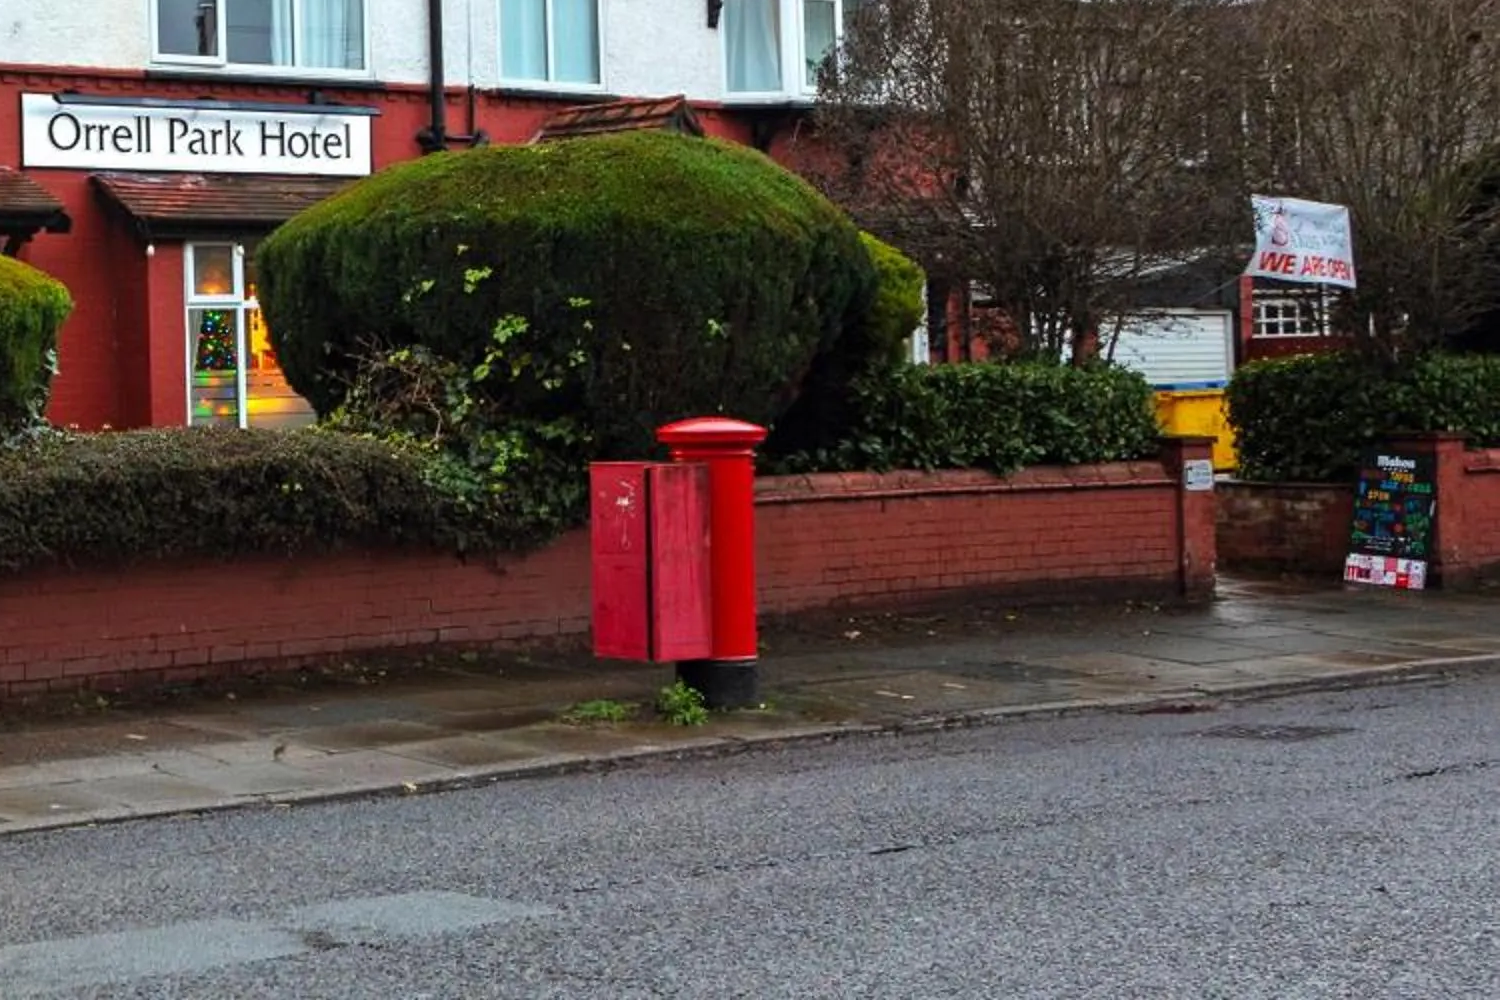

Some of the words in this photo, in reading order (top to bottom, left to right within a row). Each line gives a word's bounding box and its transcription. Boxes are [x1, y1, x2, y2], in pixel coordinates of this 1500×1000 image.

[48, 113, 151, 153] Orrell
[169, 117, 244, 156] Park
[260, 120, 351, 159] Hotel
[1258, 252, 1296, 275] WE
[1300, 255, 1325, 276] ARE
